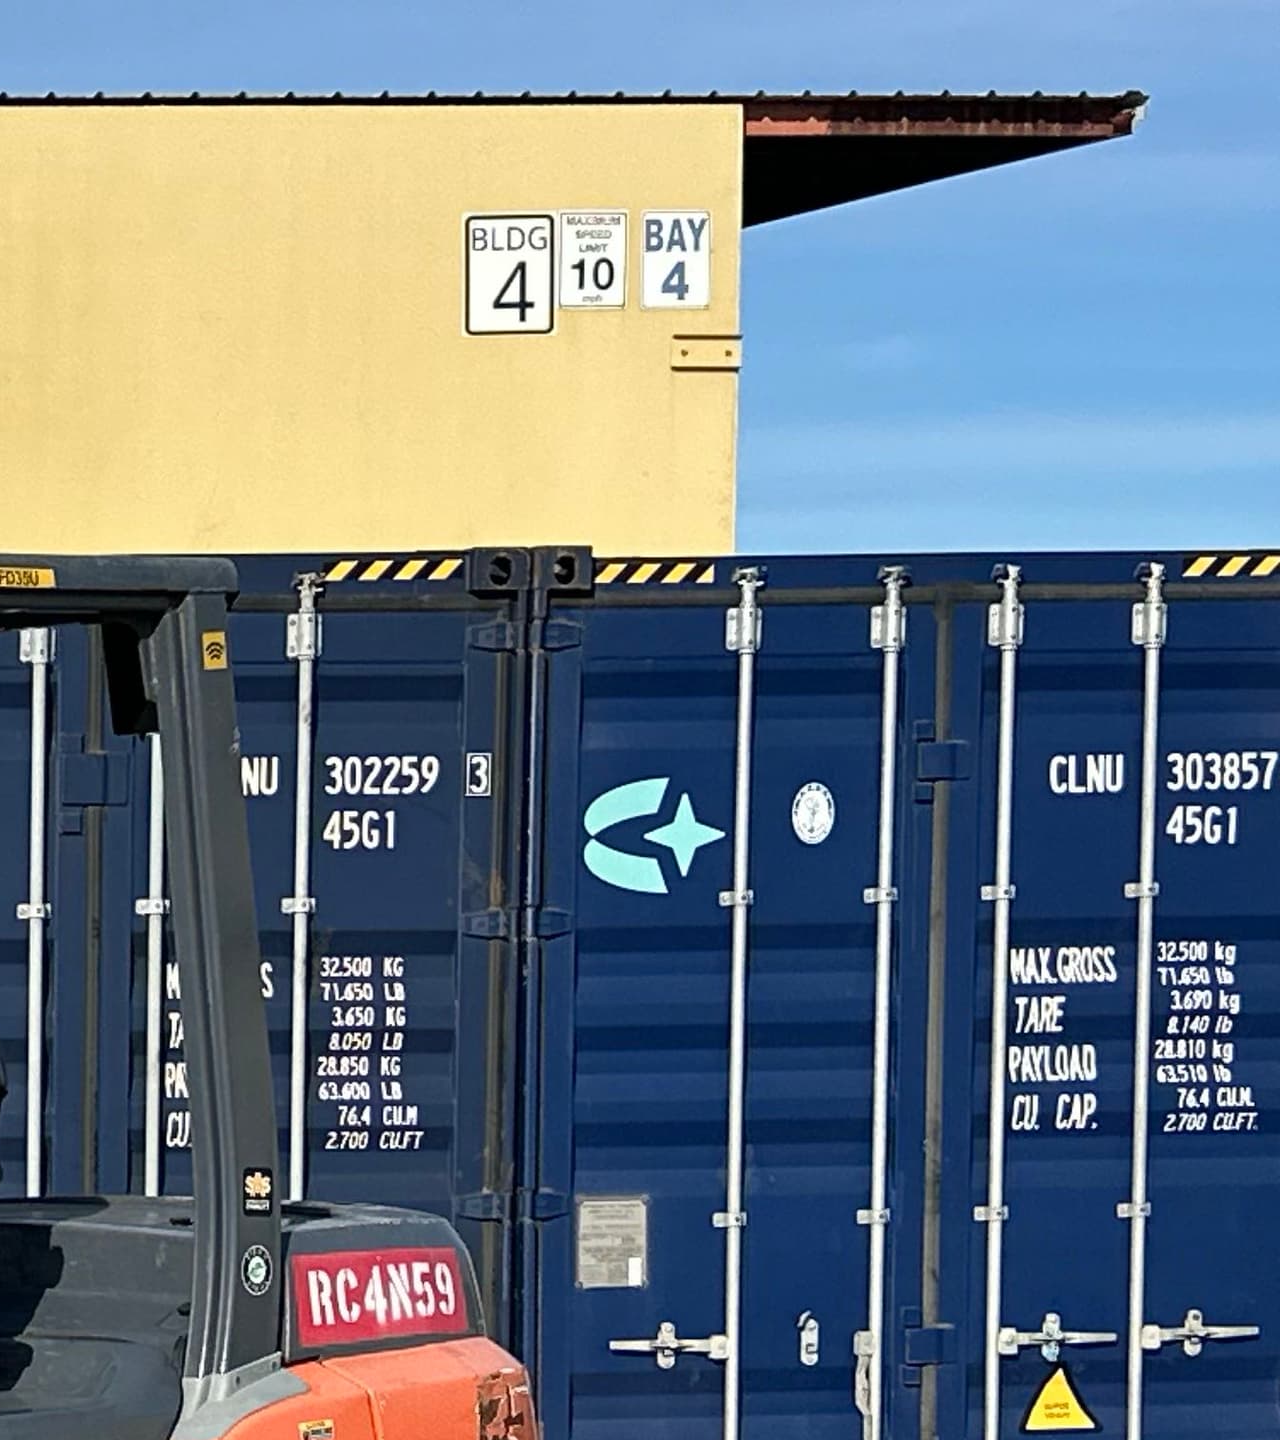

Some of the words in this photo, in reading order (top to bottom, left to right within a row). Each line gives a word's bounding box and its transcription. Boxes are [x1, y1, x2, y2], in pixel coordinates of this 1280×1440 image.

[471, 226, 548, 252] BLDG
[644, 217, 709, 253] BAY
[570, 257, 615, 291] 10
[660, 259, 690, 301] 4
[492, 260, 535, 323] 4
[241, 756, 280, 796] NU
[323, 755, 440, 795] 302259
[469, 755, 490, 794] 3
[1048, 753, 1124, 793] CLNU
[1166, 752, 1278, 791] 303857
[322, 810, 396, 850] 45G1
[1166, 805, 1238, 845] 45G1
[1214, 941, 1236, 965] kg
[319, 957, 372, 978] 32.500
[383, 957, 405, 978] KG
[1214, 966, 1235, 985] lb
[384, 982, 406, 1001] LB
[1218, 990, 1240, 1015] kg
[385, 1006, 406, 1027] KG
[1014, 996, 1066, 1034] TARE
[1215, 1015, 1233, 1034] lb
[382, 1032, 404, 1051] LB
[1212, 1039, 1234, 1064] kg
[380, 1056, 401, 1076] KG
[1008, 1044, 1098, 1083] PAYLOAD
[1212, 1064, 1232, 1083] lb
[381, 1081, 403, 1101] LB
[1054, 1092, 1099, 1130] CAP.
[307, 1261, 457, 1327] RC4N59
